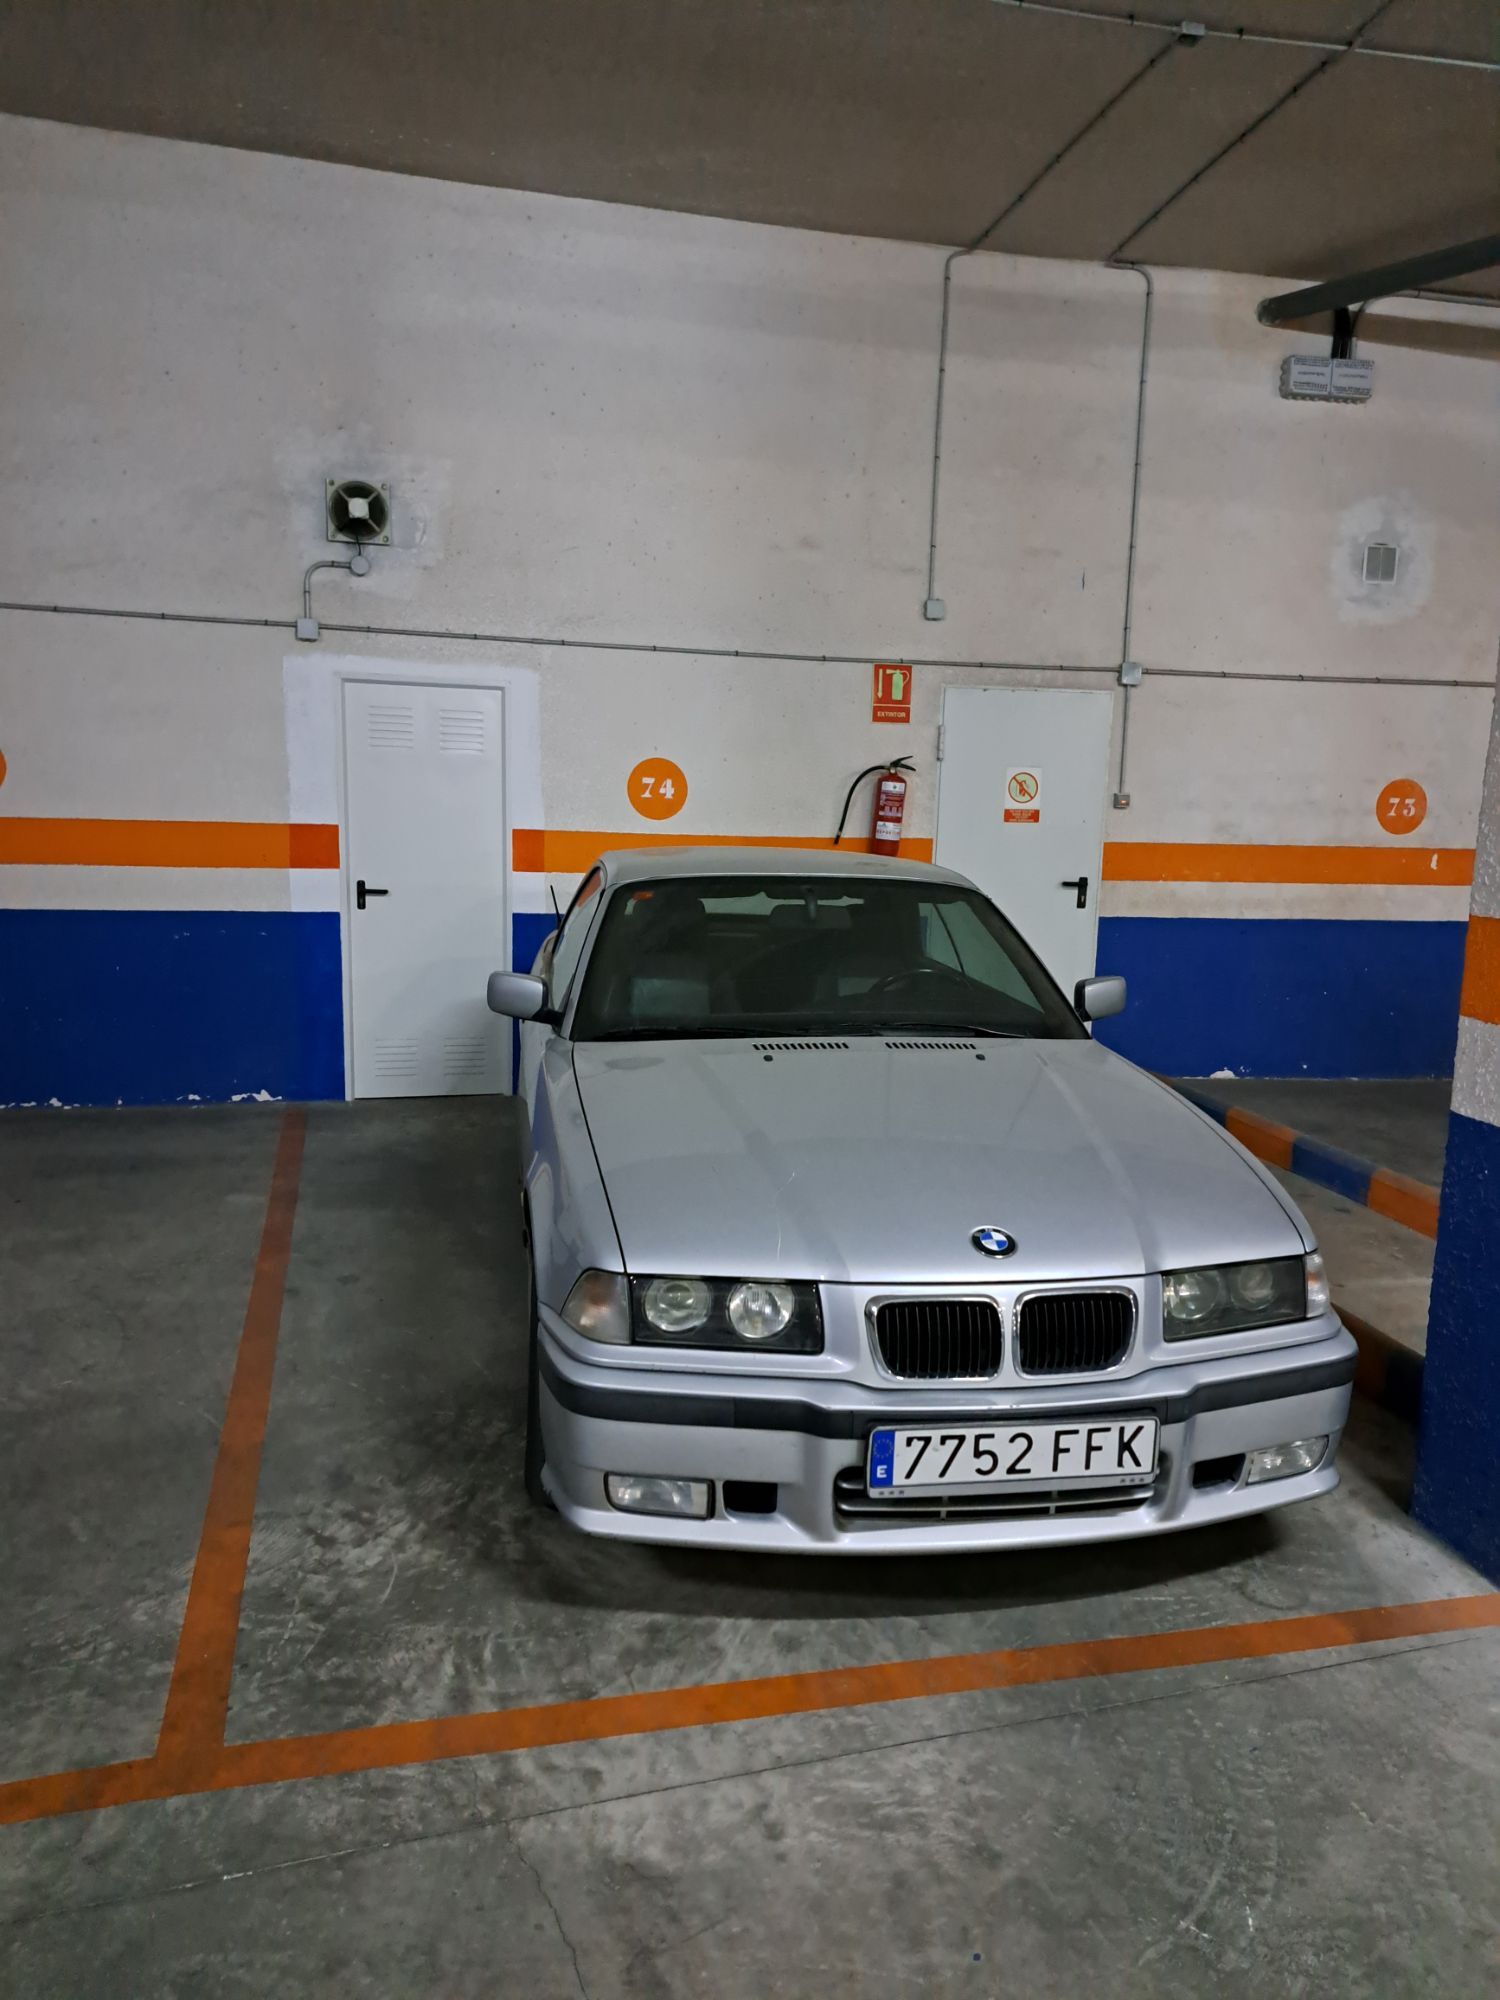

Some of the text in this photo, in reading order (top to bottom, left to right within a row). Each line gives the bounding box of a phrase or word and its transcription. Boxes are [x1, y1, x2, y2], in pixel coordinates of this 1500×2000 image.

[640, 777, 675, 799] 74
[1387, 797, 1416, 817] 73
[904, 1425, 1145, 1480] 7752 FFK
[876, 1465, 887, 1478] E
